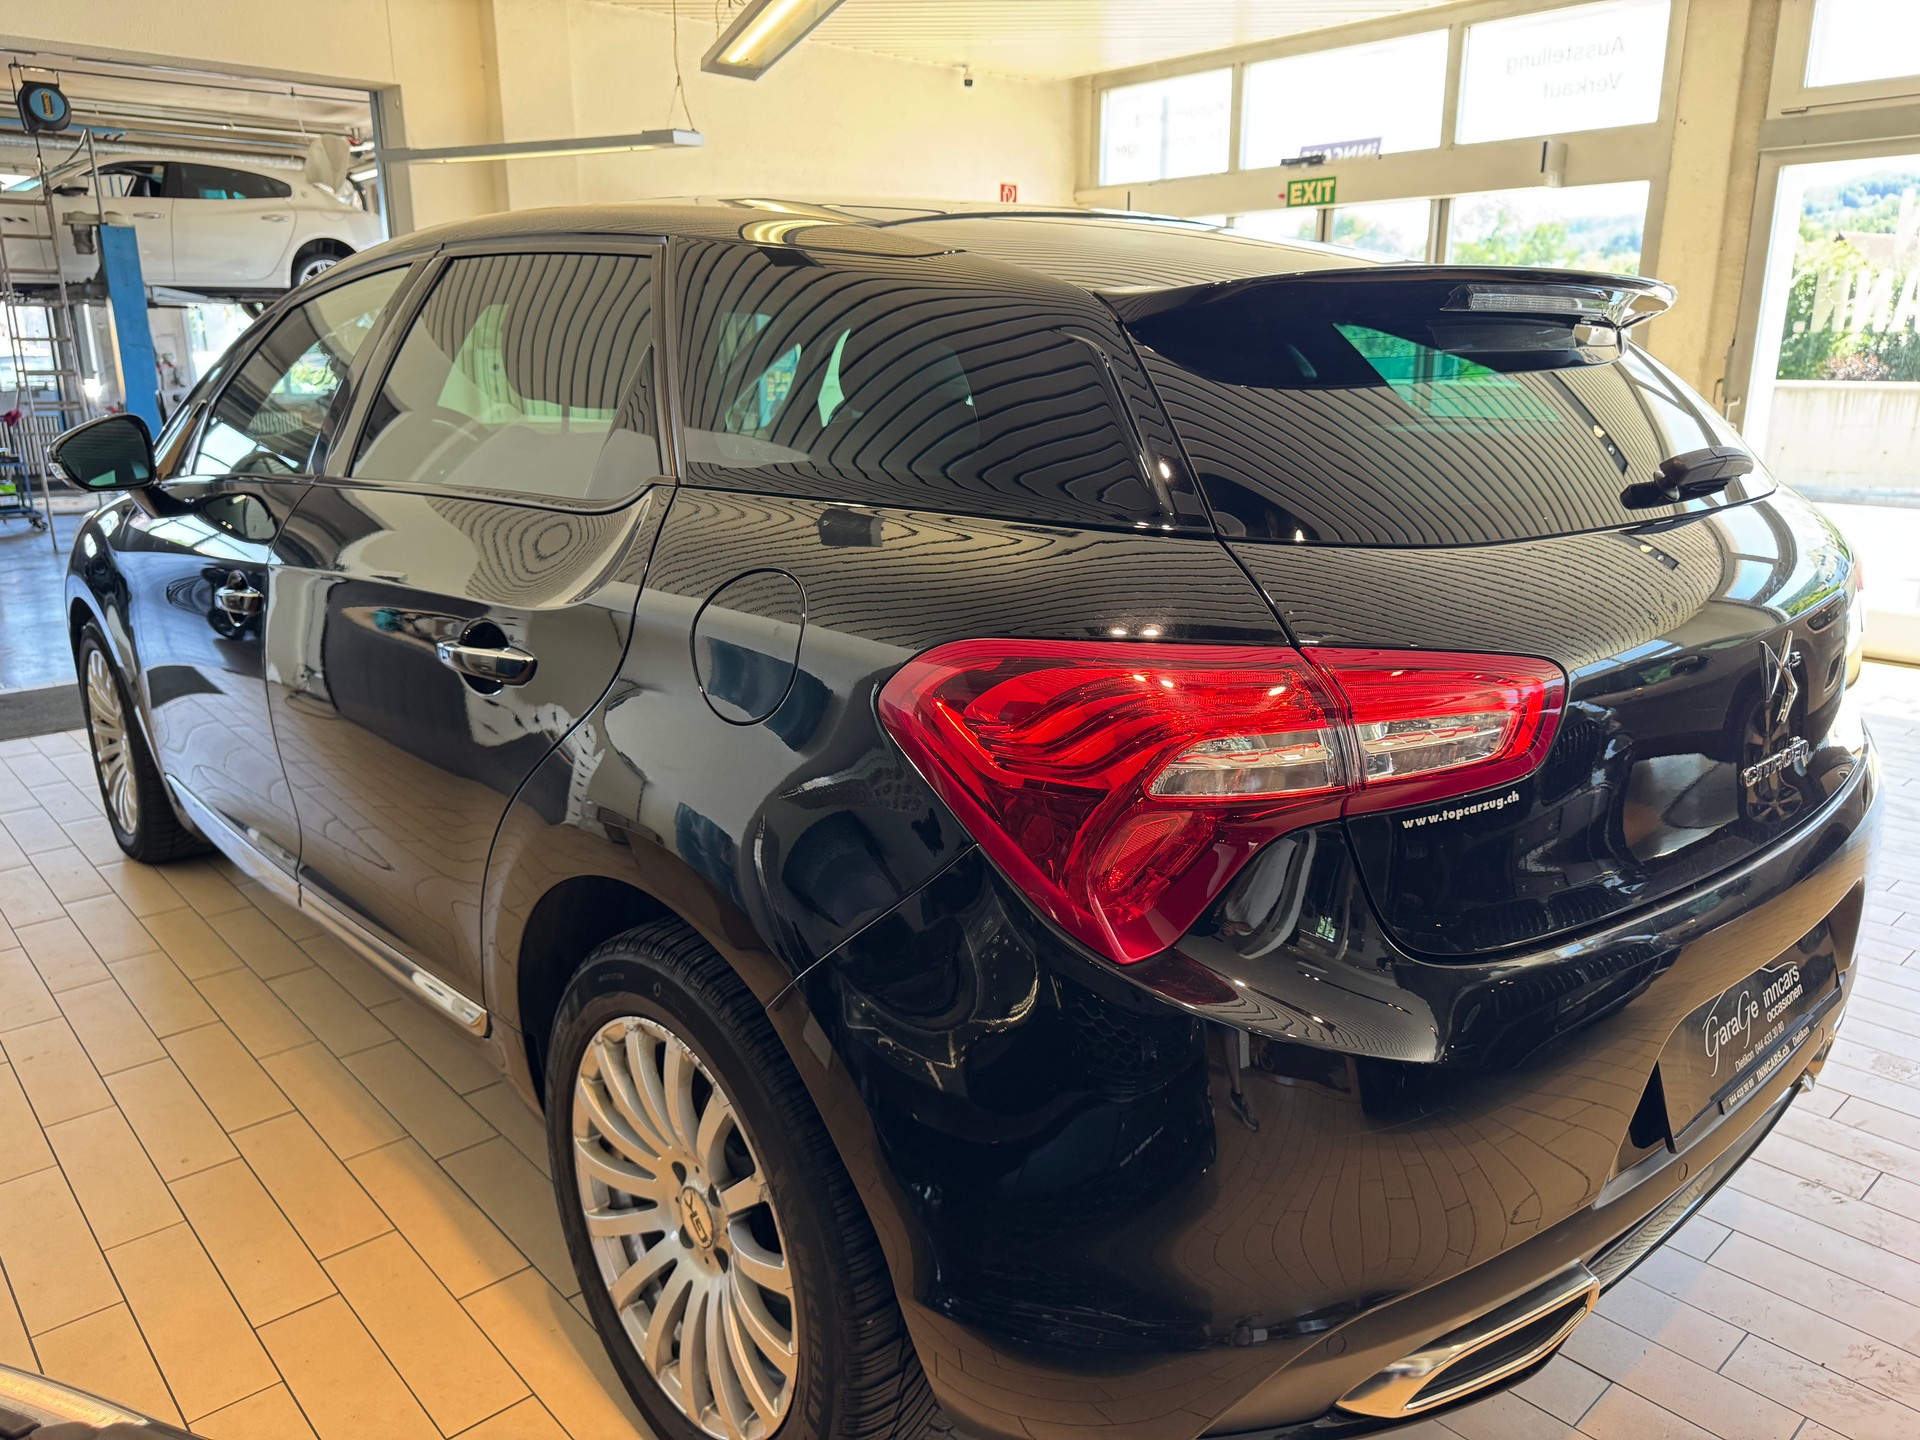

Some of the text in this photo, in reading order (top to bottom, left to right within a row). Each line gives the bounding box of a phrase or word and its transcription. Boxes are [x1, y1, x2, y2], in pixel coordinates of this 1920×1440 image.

[1289, 180, 1335, 205] EXIT
[1402, 790, 1520, 829] www.topcarzug.ch
[1762, 965, 1800, 1009] inncars
[1766, 983, 1803, 1023] occasionen
[1734, 1050, 1755, 1073] Dietikon
[1756, 1044, 1790, 1081] INNCARS.ch
